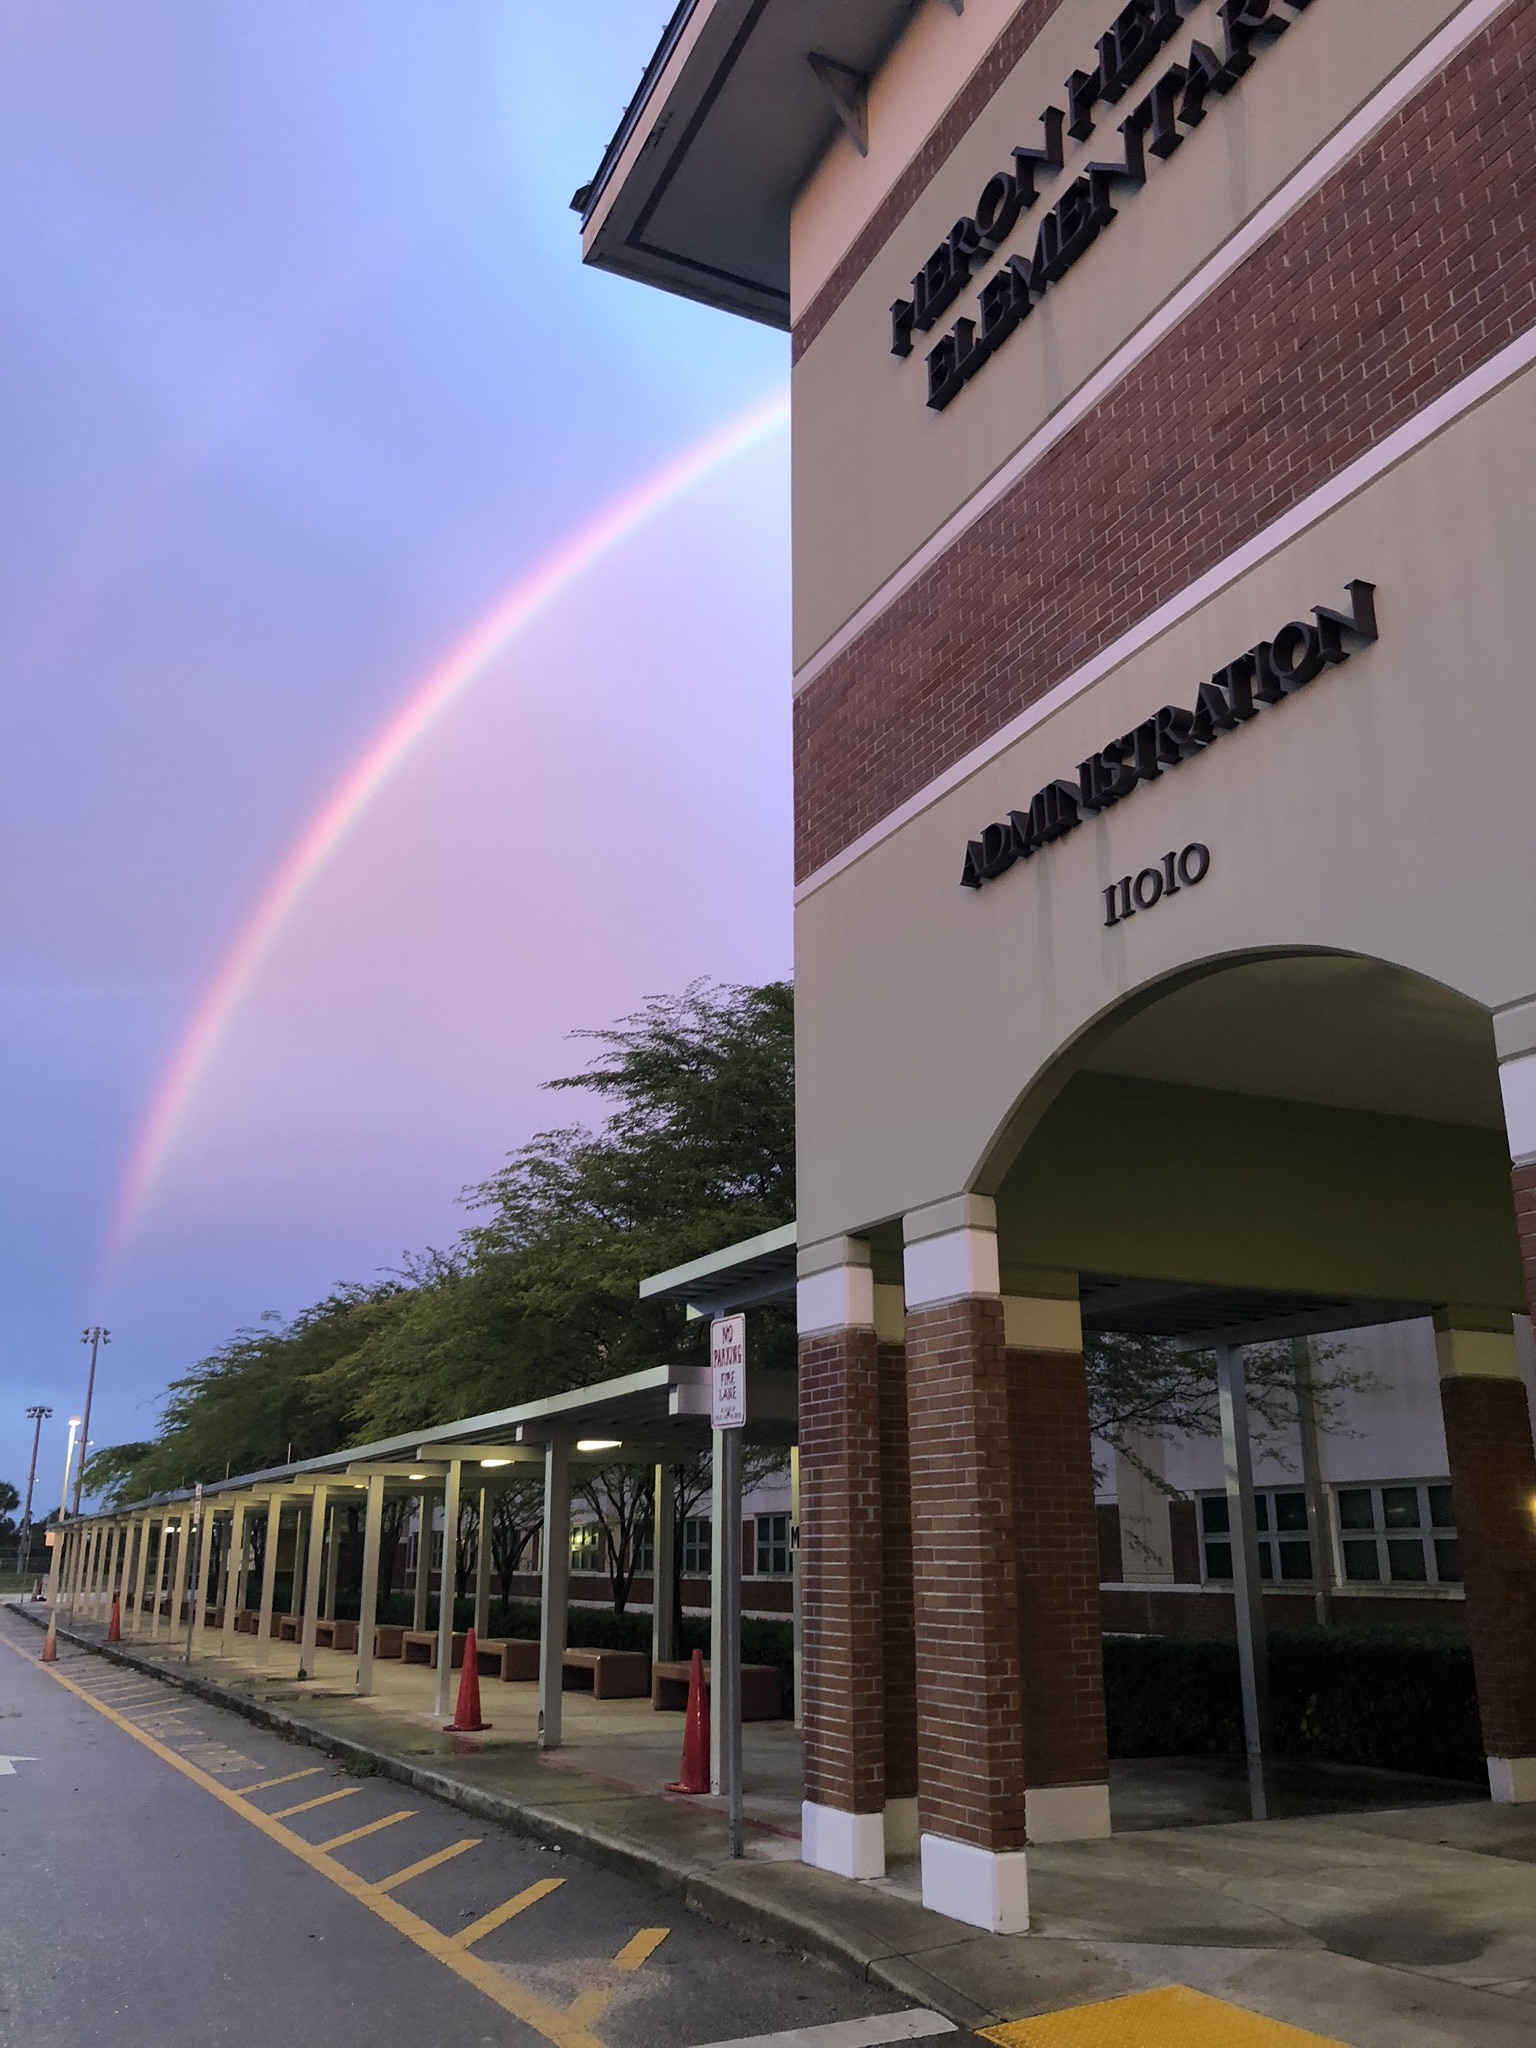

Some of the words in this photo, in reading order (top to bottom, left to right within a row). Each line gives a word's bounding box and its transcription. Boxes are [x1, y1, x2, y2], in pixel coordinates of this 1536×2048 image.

[924, 0, 1312, 411] ELEMENTAR
[888, 105, 1064, 358] HERON
[959, 579, 1379, 890] ADMINISTRATION
[722, 1324, 733, 1344] NO
[713, 1344, 742, 1367] PARKING
[720, 1371, 735, 1387] FIRE
[719, 1386, 737, 1401] LANE
